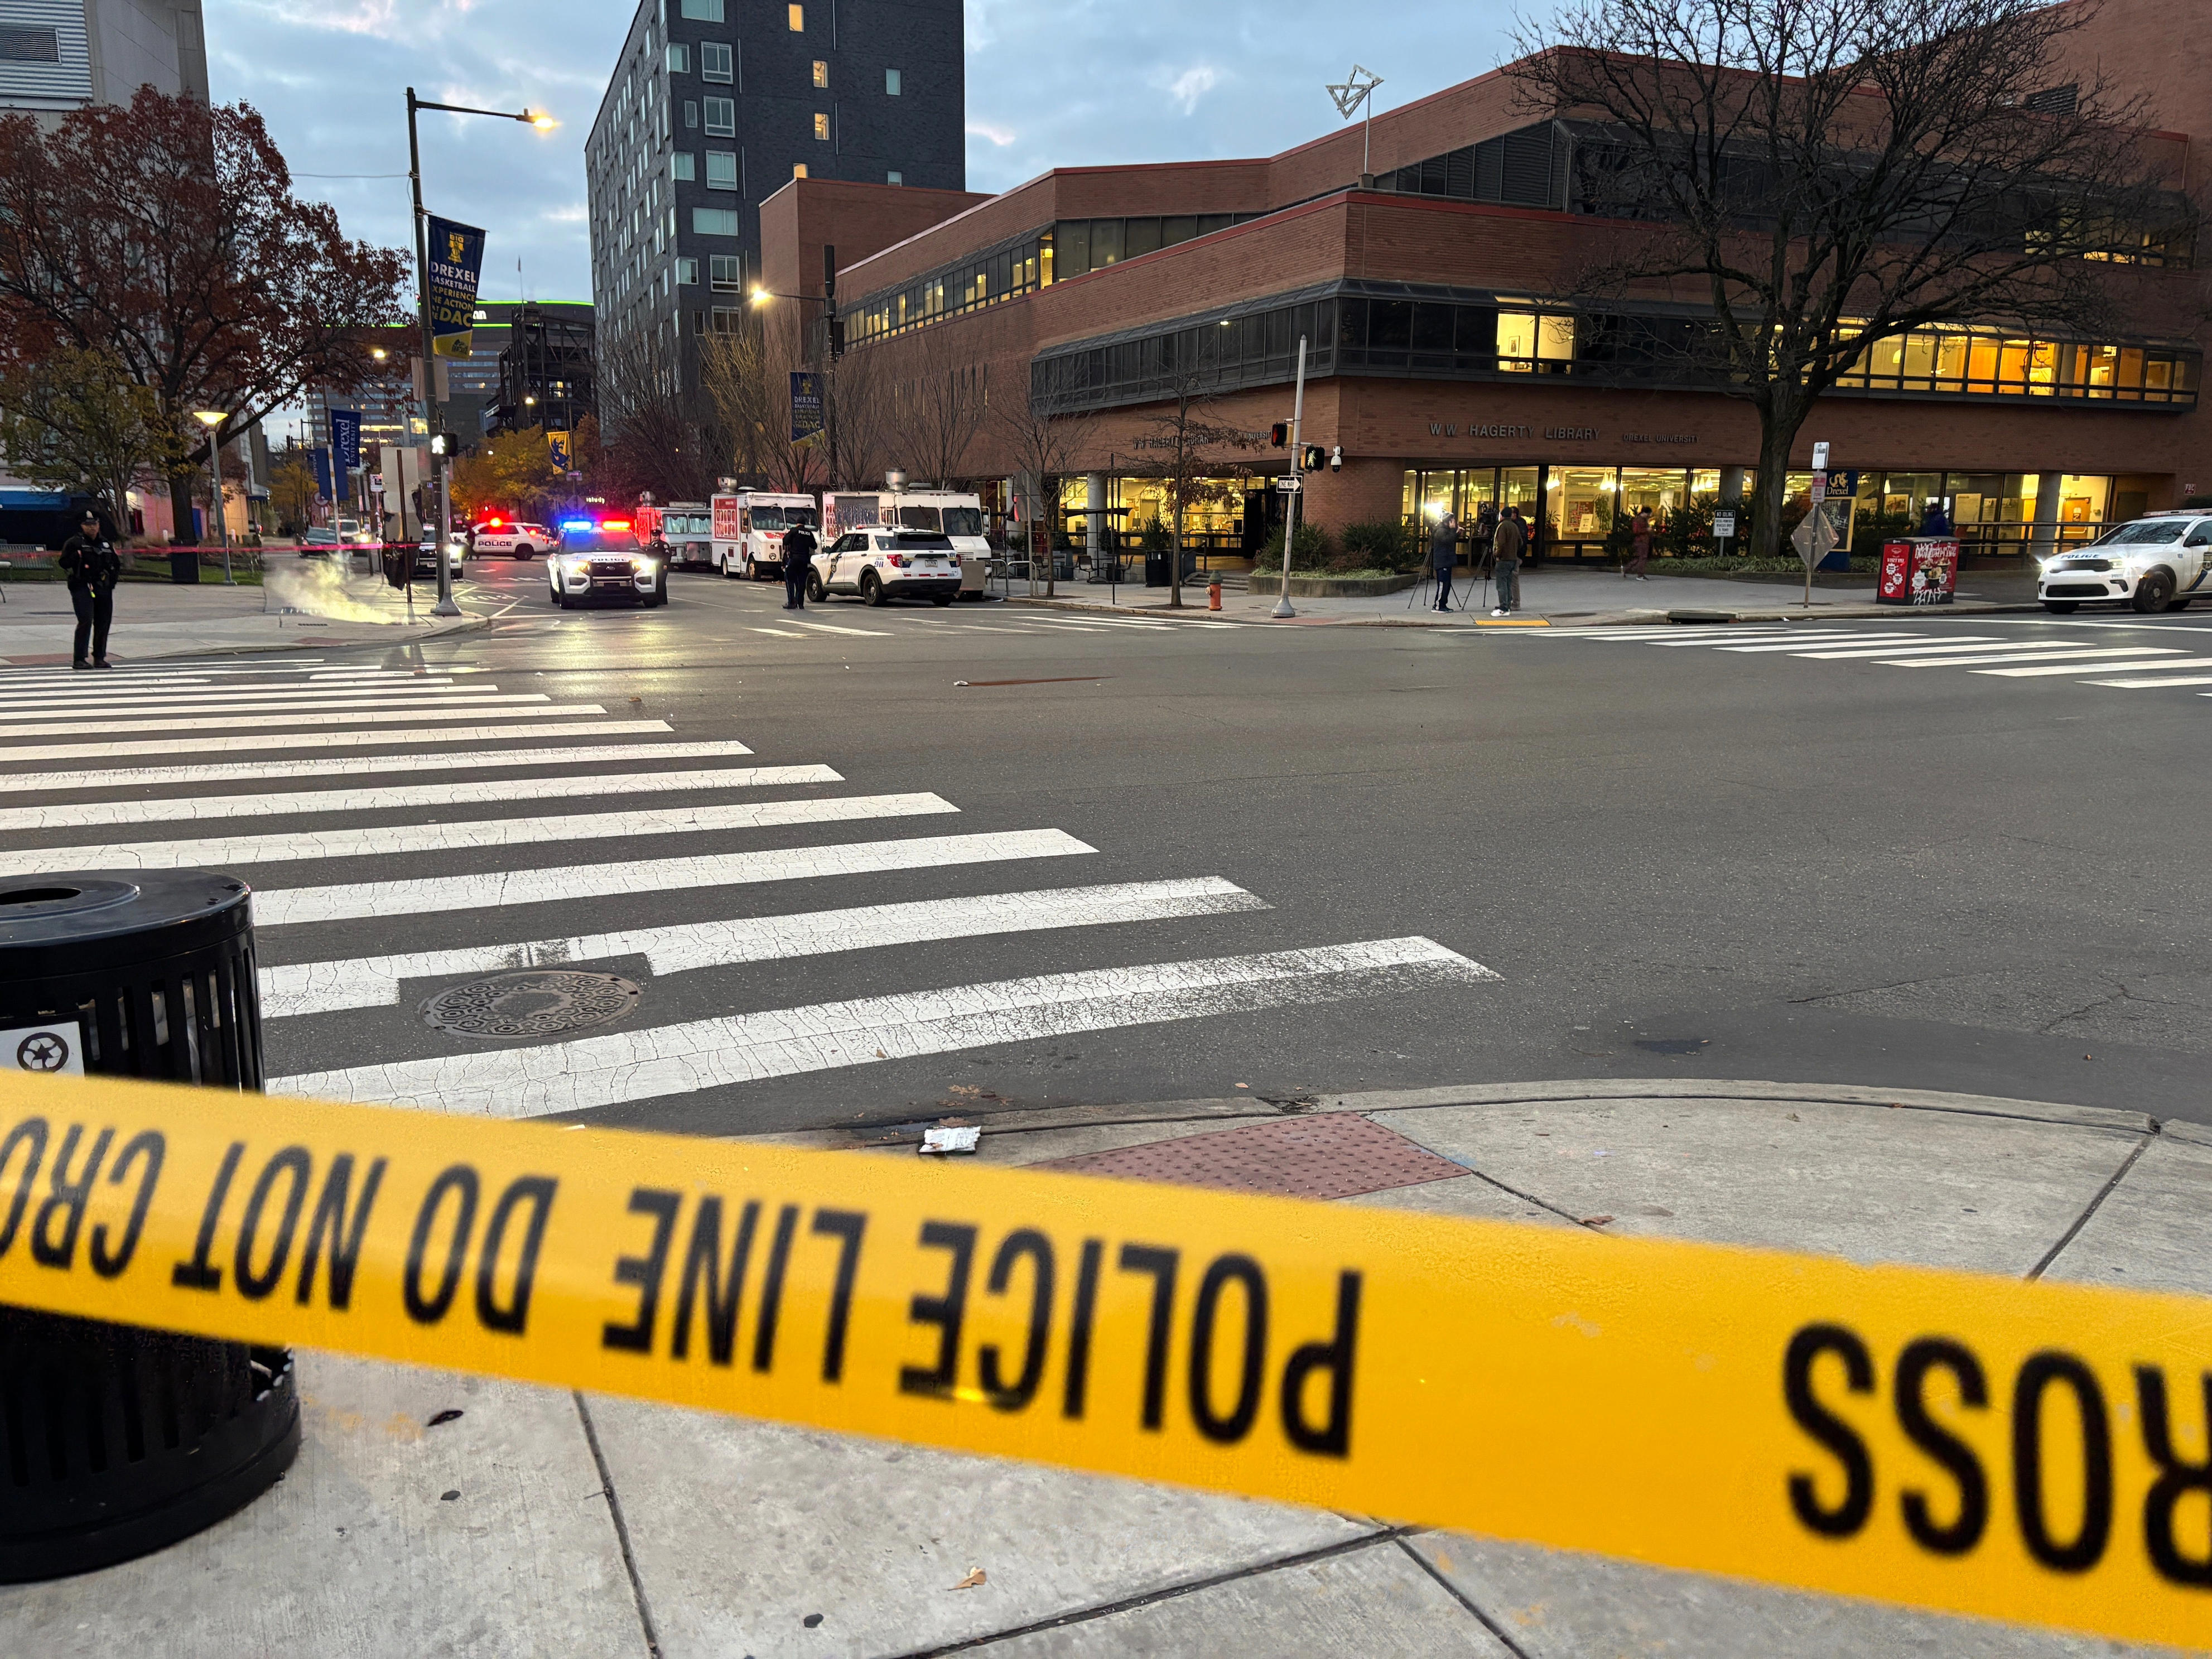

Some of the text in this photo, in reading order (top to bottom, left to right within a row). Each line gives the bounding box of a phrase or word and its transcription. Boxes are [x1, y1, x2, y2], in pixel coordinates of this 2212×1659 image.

[450, 234, 464, 243] BIG
[431, 261, 476, 283] DREXEL
[432, 285, 475, 302] XPERIENCE
[444, 298, 474, 312] ACTION
[439, 307, 473, 328] DAC
[1469, 425, 1534, 438] HAGERTY
[1545, 427, 1601, 440] LIBRARY
[1623, 433, 1699, 442] DREXEL UNIVERSITY
[1827, 486, 1849, 495] Drexel
[171, 1140, 389, 1311] NOT
[402, 1163, 560, 1337] DO
[600, 1185, 870, 1385] LINE
[898, 1219, 1365, 1460] POLICE
[1781, 1320, 2212, 1592] ROSS
